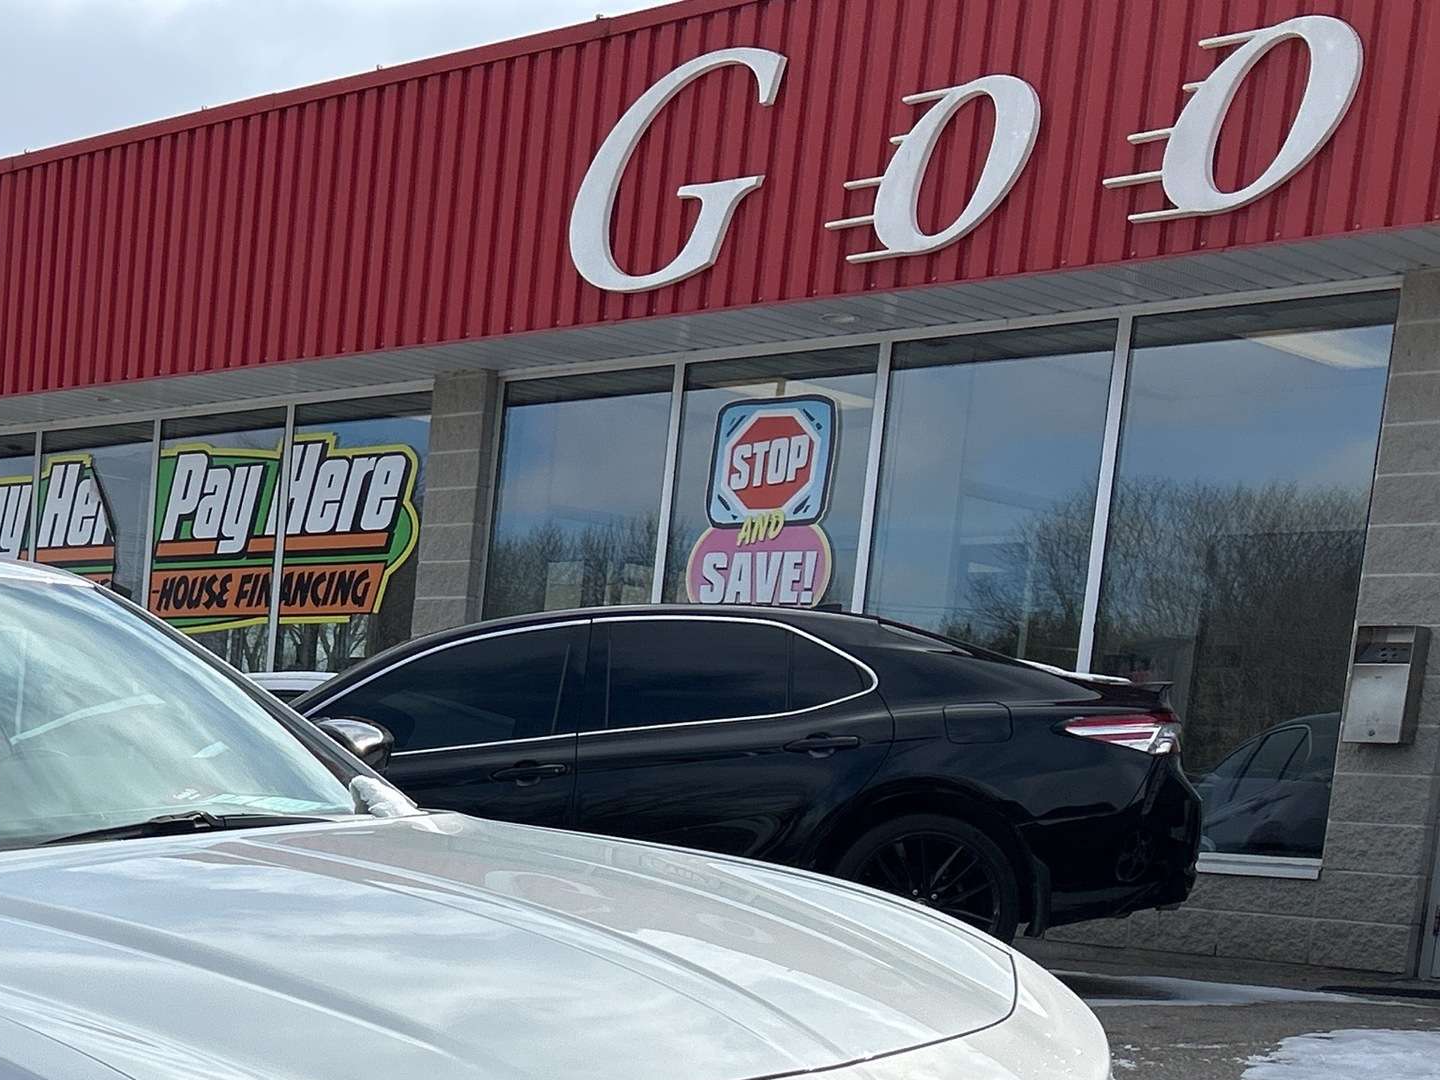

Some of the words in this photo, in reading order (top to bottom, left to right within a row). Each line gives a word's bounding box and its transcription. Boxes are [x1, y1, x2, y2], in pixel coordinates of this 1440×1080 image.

[729, 434, 810, 490] STOP
[160, 453, 263, 554] Pay
[264, 443, 406, 536] Here
[736, 510, 785, 547] AND
[235, 568, 372, 609] FINANCING
[699, 550, 818, 605] SAVE!
